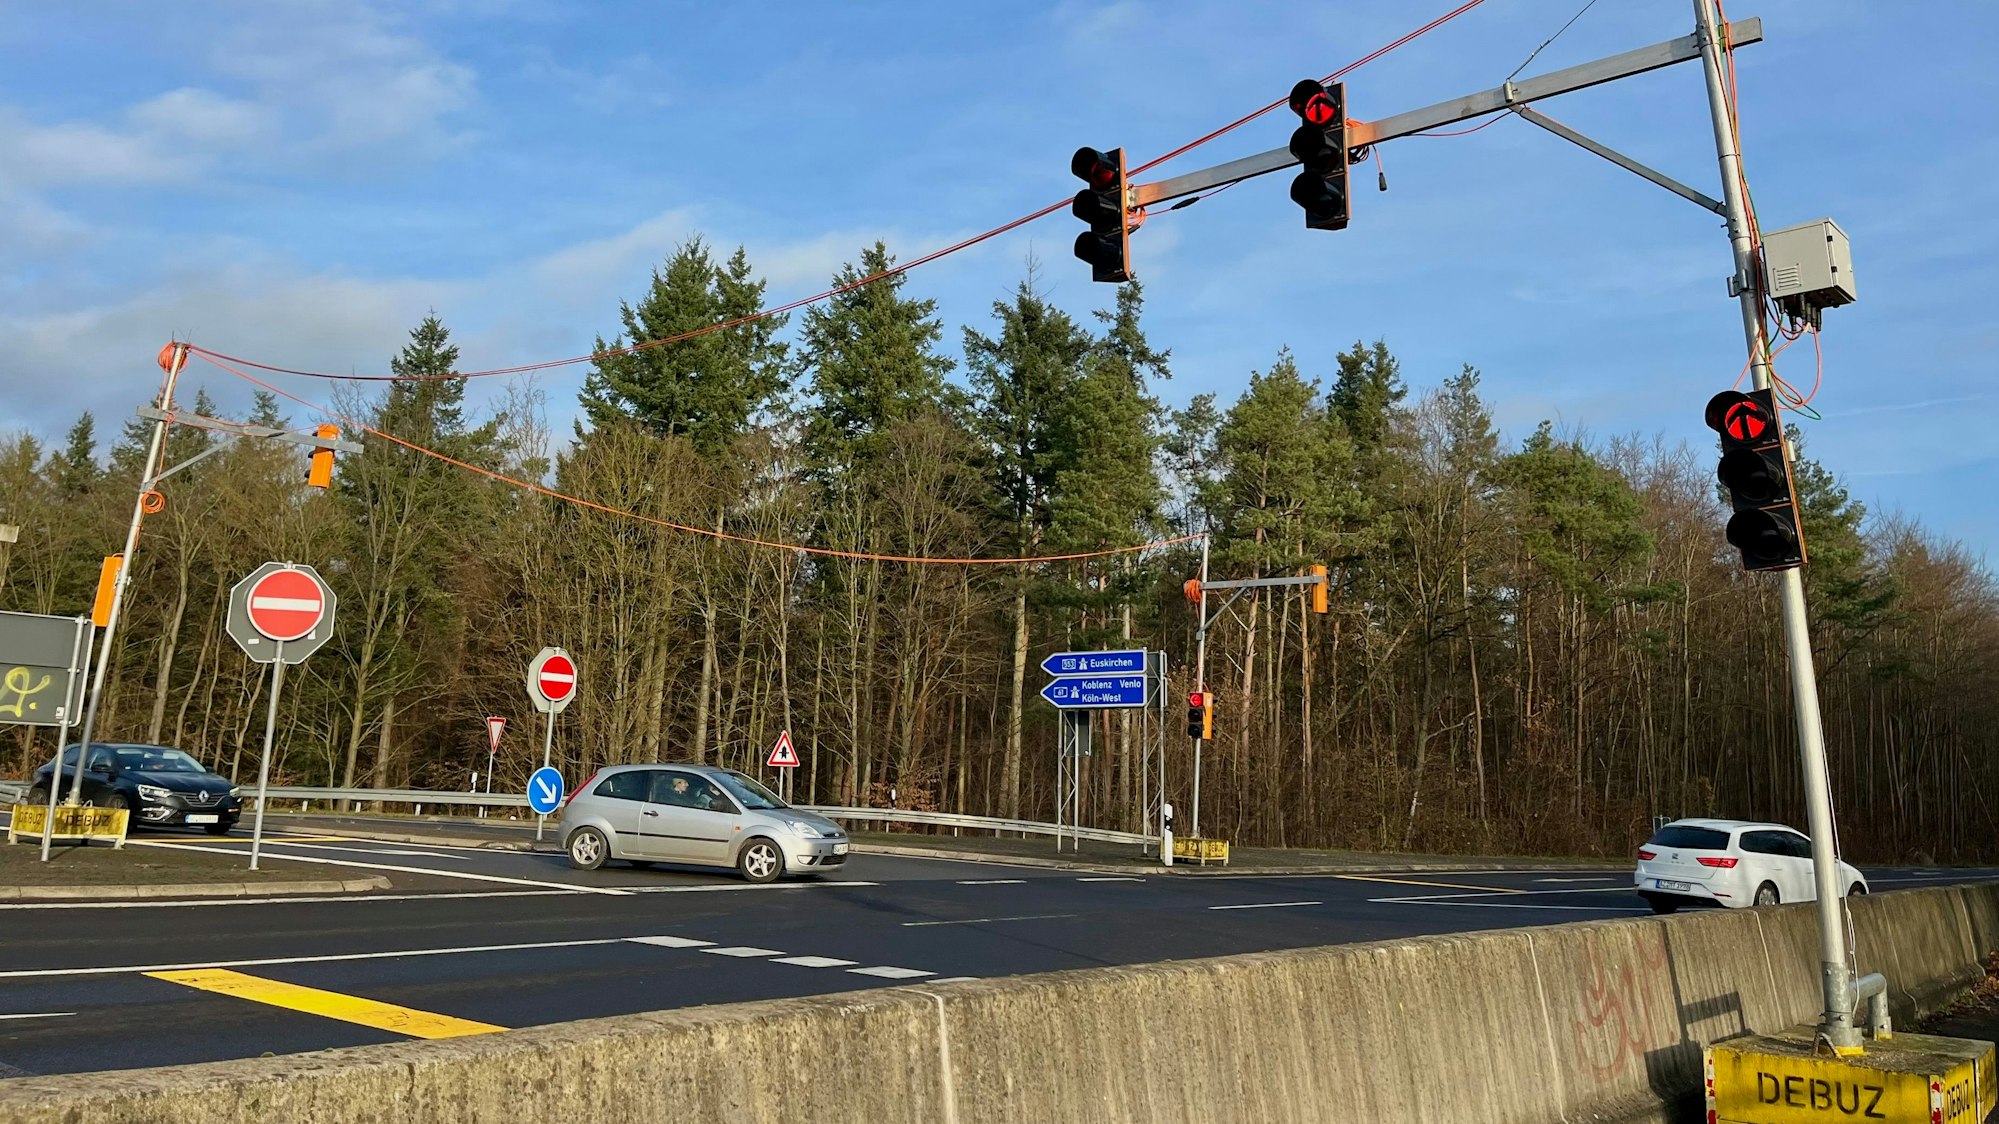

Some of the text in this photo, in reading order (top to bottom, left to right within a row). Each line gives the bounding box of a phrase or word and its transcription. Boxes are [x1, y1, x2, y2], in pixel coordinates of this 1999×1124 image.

[1090, 658, 1133, 668] Euskirchen
[1082, 680, 1141, 690] Koblenz Venlo
[1082, 693, 1121, 703] Köln-West
[19, 811, 43, 825] DEBUZ
[65, 814, 112, 827] DEBUZ
[1757, 1072, 1886, 1119] DEBUZ
[1947, 1079, 1970, 1120] DEBUZ
